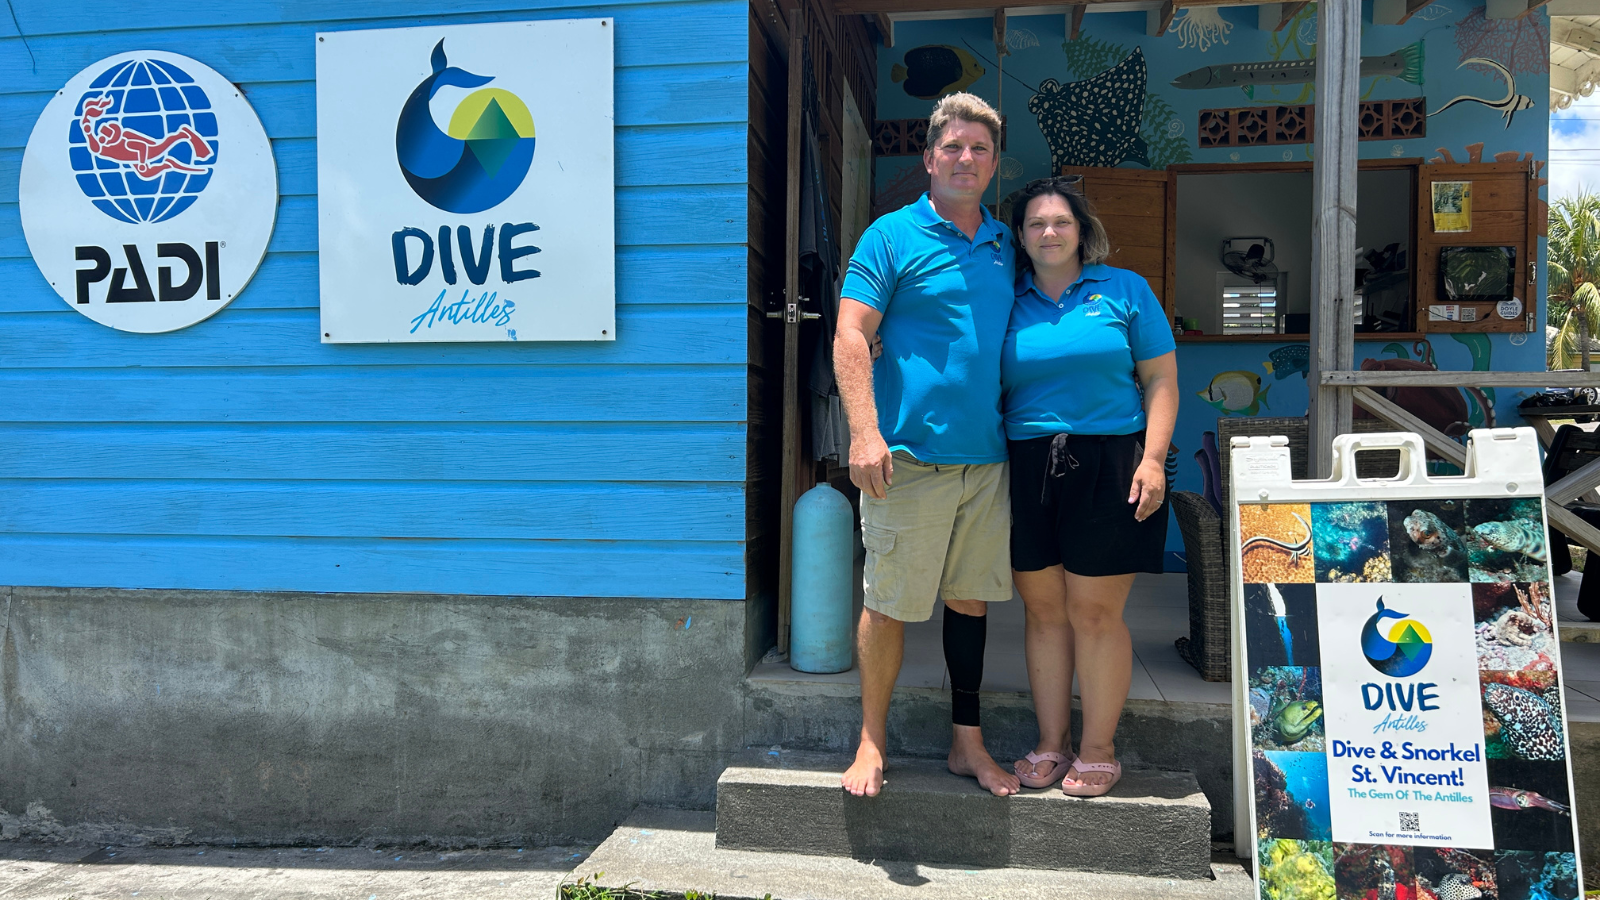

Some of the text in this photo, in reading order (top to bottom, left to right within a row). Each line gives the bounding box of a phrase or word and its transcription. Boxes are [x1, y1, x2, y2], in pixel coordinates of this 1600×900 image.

[391, 222, 542, 286] DIVE
[75, 241, 221, 304] PADI
[410, 289, 516, 334] Antilles
[1361, 682, 1440, 712] DIVE
[1373, 713, 1428, 734] Antilles
[1332, 740, 1480, 762] Dive & Snorkel
[1351, 764, 1465, 787] St. Vincent!
[1347, 788, 1473, 803] The Gem Of The Antilles
[1414, 833, 1452, 841] information
